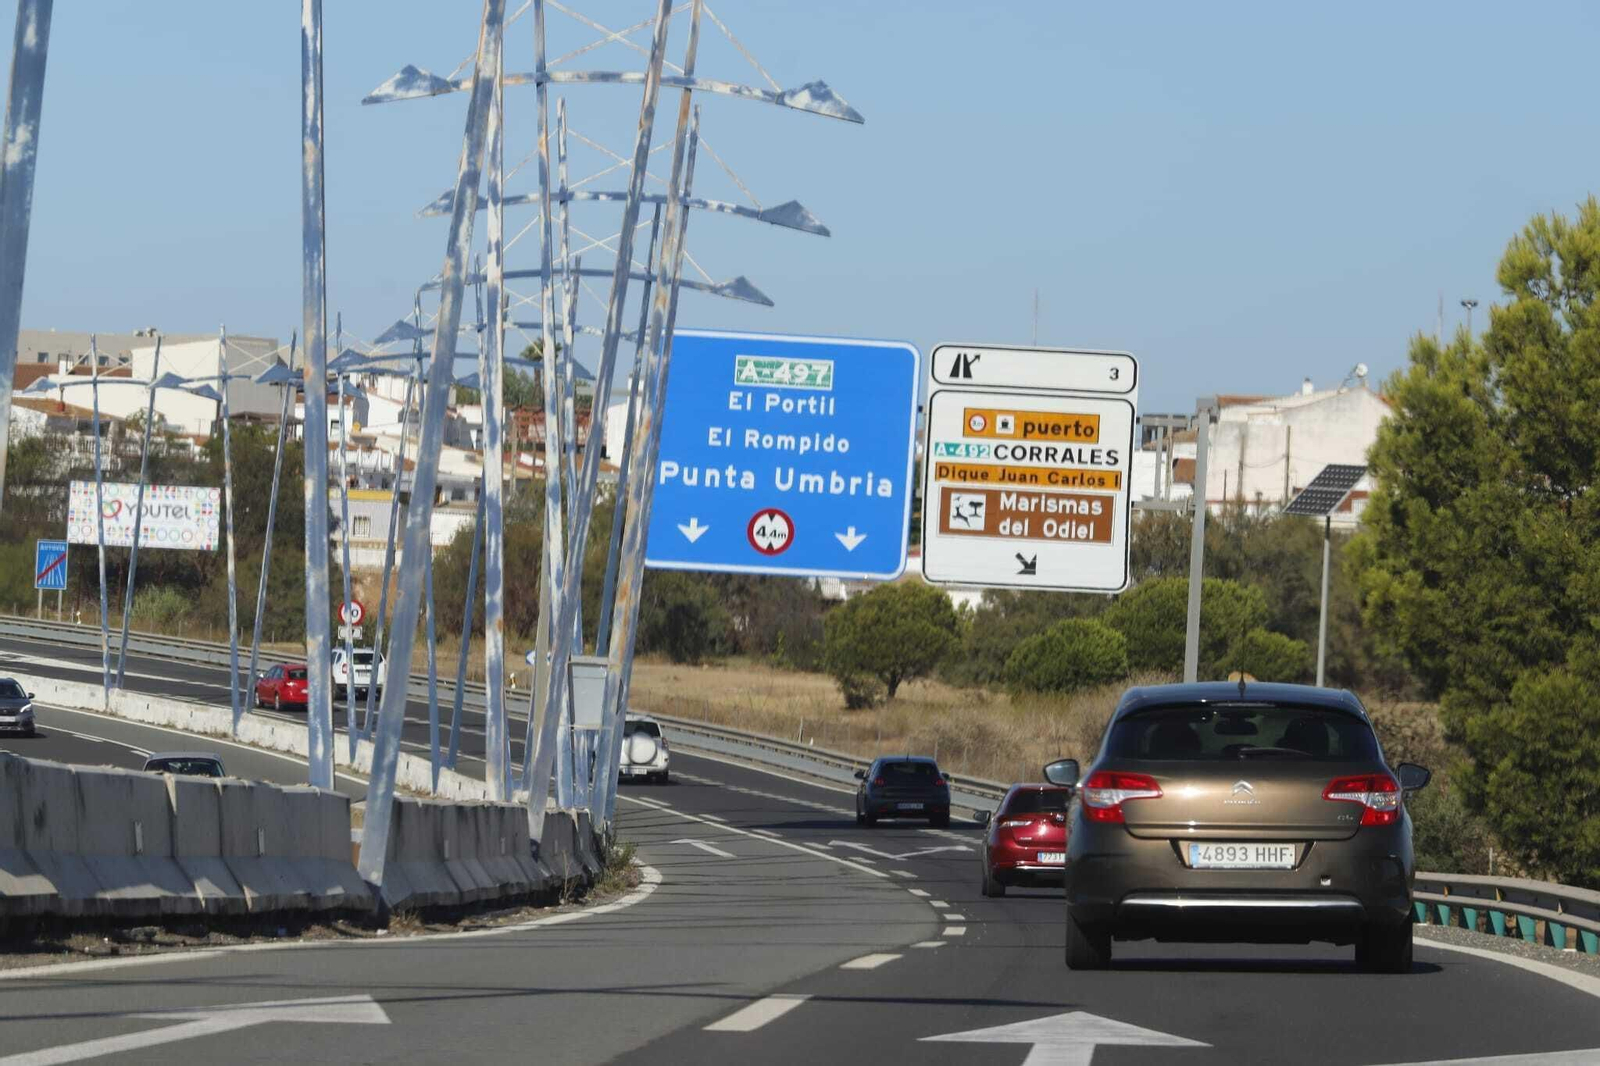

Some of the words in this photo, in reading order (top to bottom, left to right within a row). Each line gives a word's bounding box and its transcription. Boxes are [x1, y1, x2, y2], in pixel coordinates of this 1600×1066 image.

[738, 359, 830, 386] A-497
[1109, 367, 1120, 381] 3
[728, 391, 752, 411] El
[765, 393, 835, 416] Portil
[708, 427, 731, 447] El
[744, 429, 850, 455] Rompido
[1023, 420, 1095, 439] puerto
[936, 443, 988, 459] A-492
[994, 444, 1119, 466] CORRALES
[659, 461, 755, 490] Punta
[775, 467, 893, 498] Umbria
[938, 465, 989, 483] Dique
[998, 469, 1039, 484] Juan
[1047, 472, 1106, 487] Carlos
[999, 491, 1103, 516] Marismas
[999, 517, 1029, 537] del
[1042, 518, 1095, 540] Odiel
[1202, 846, 1249, 862] 4893
[1255, 847, 1290, 862] HHF
